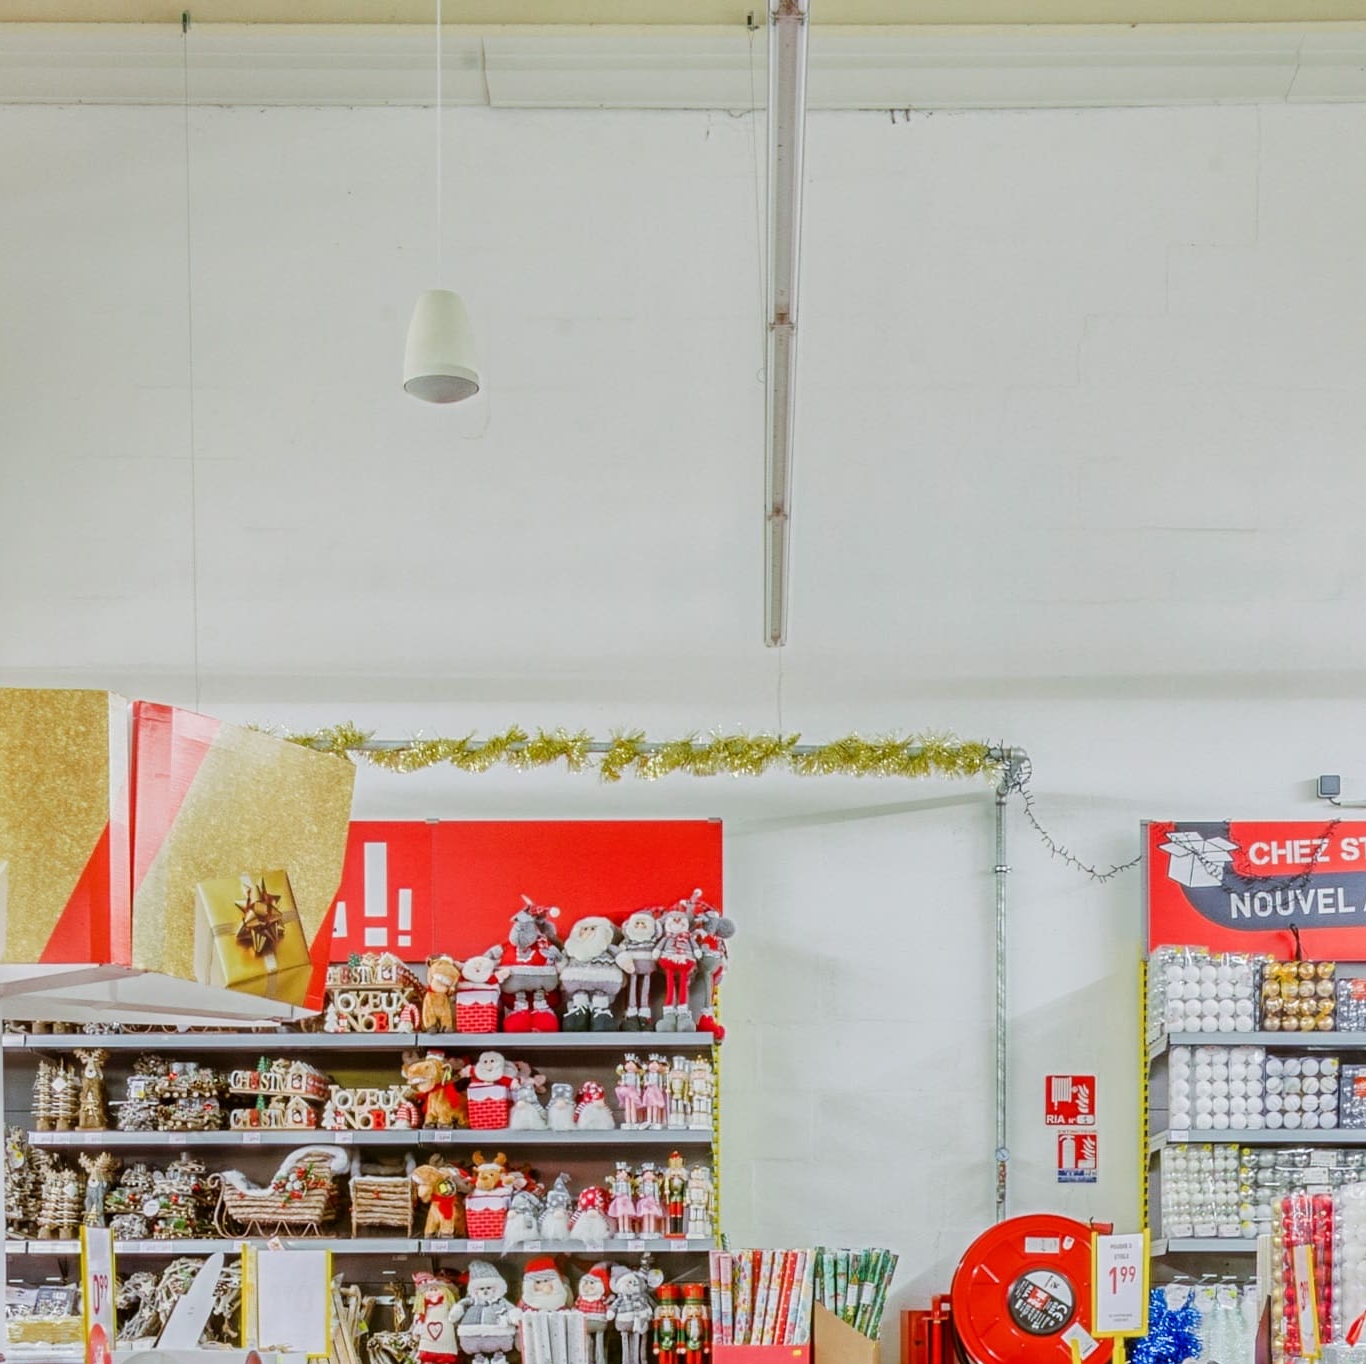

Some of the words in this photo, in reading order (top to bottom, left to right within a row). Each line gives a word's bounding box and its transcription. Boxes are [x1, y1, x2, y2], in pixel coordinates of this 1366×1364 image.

[1249, 839, 1330, 865] CHEZ
[1230, 886, 1355, 919] NOUVEL
[1046, 1114, 1065, 1124] RIA
